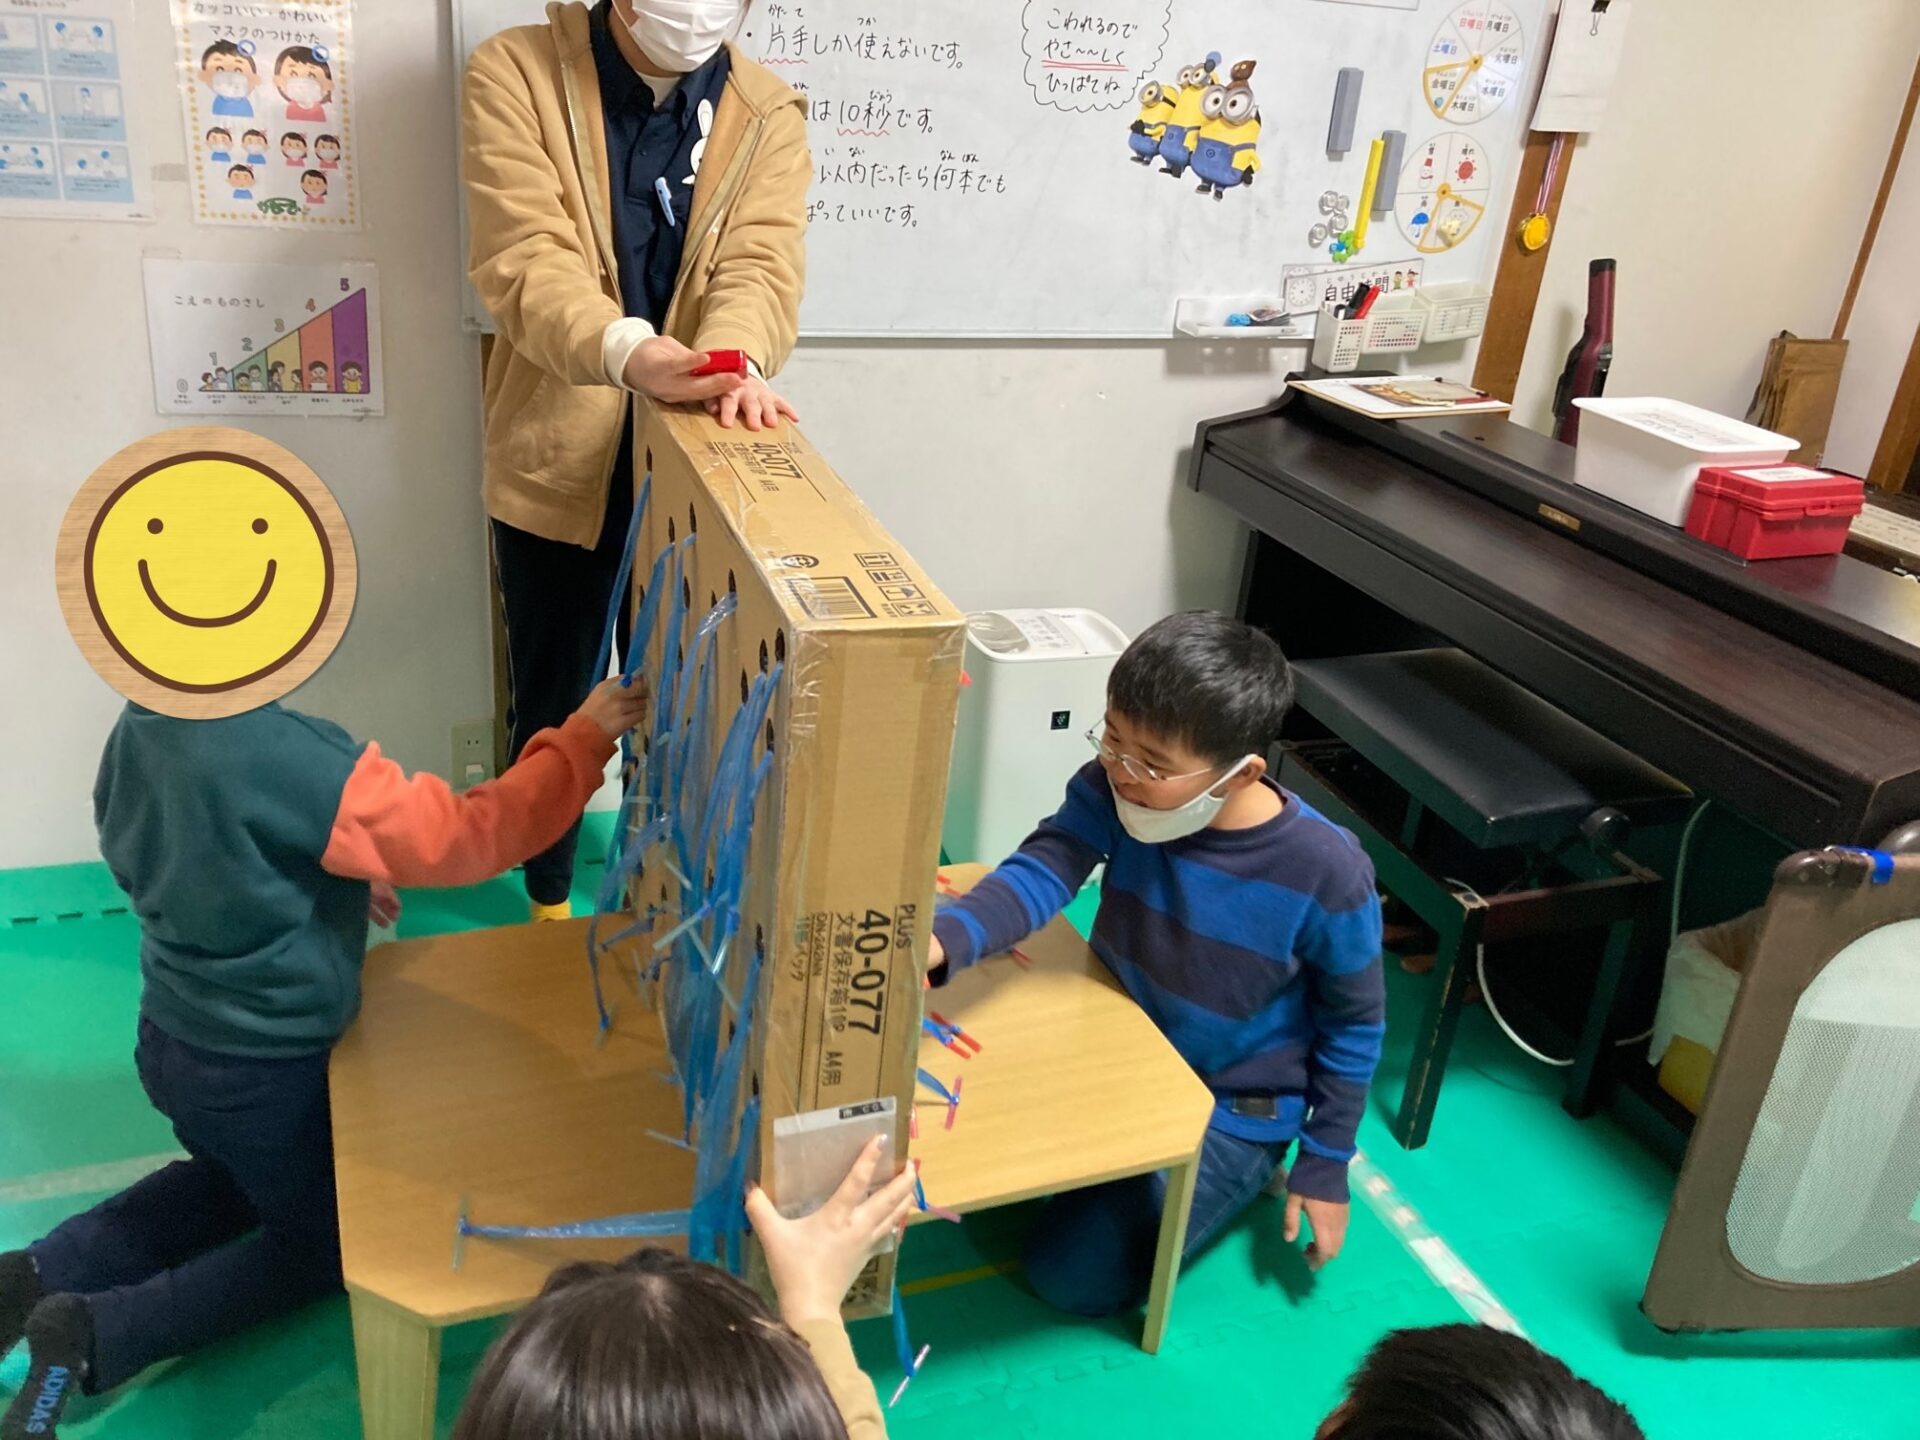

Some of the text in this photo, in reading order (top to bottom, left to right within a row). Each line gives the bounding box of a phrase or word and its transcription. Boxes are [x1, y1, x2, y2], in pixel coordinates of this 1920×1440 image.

[1047, 8, 1138, 39] こわれるので
[1460, 17, 1483, 30] 日曜日
[1487, 20, 1509, 33] 月曜日
[209, 25, 320, 44] マスクのつけかた
[1433, 44, 1457, 55] 土曜日
[1451, 101, 1475, 112] 木曜日
[341, 278, 350, 292] 5
[305, 298, 316, 312] 4
[273, 318, 285, 333] 3
[241, 337, 253, 352] 2
[209, 352, 218, 366] 1
[896, 903, 915, 949] PLUS
[847, 909, 891, 1036] 40-077
